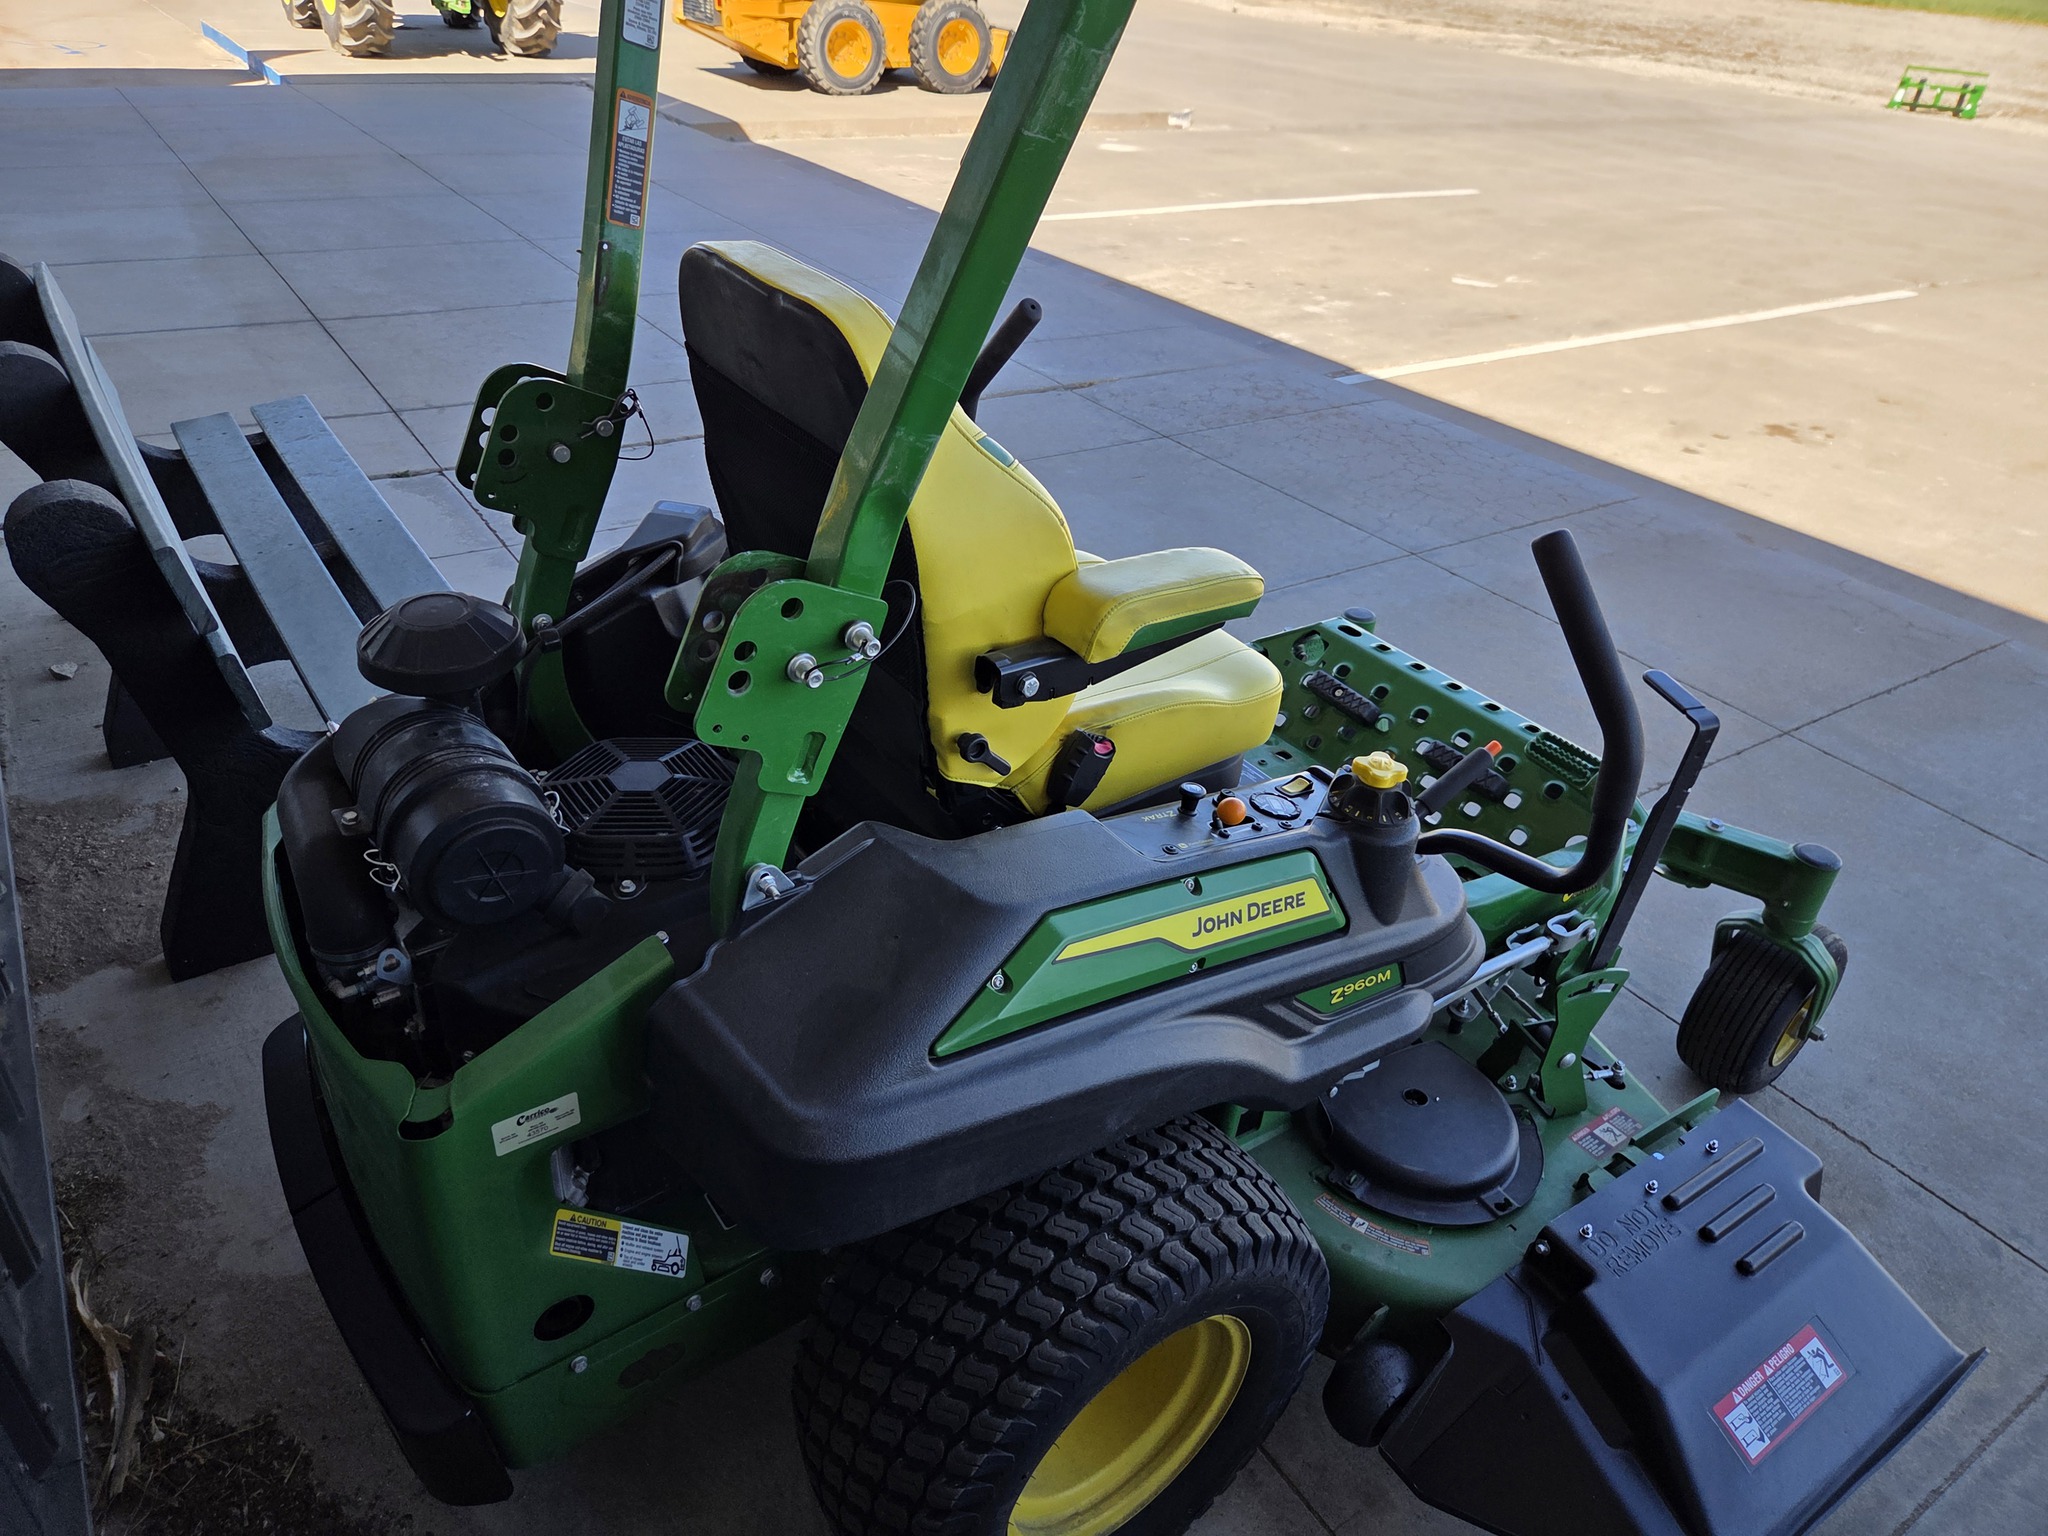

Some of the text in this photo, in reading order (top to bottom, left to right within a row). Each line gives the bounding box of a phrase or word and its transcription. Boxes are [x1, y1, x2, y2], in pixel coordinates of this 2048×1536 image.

[1192, 891, 1306, 938] JOHN DEERE
[1331, 969, 1391, 1005] Z960M
[516, 1107, 550, 1127] Carrico
[577, 1214, 607, 1228] CAUTION
[1584, 1200, 1659, 1257] DO NOT
[1603, 1216, 1682, 1278] REMOVE
[1736, 1370, 1765, 1397] DANGER
[1767, 1342, 1795, 1370] PELIGRO
